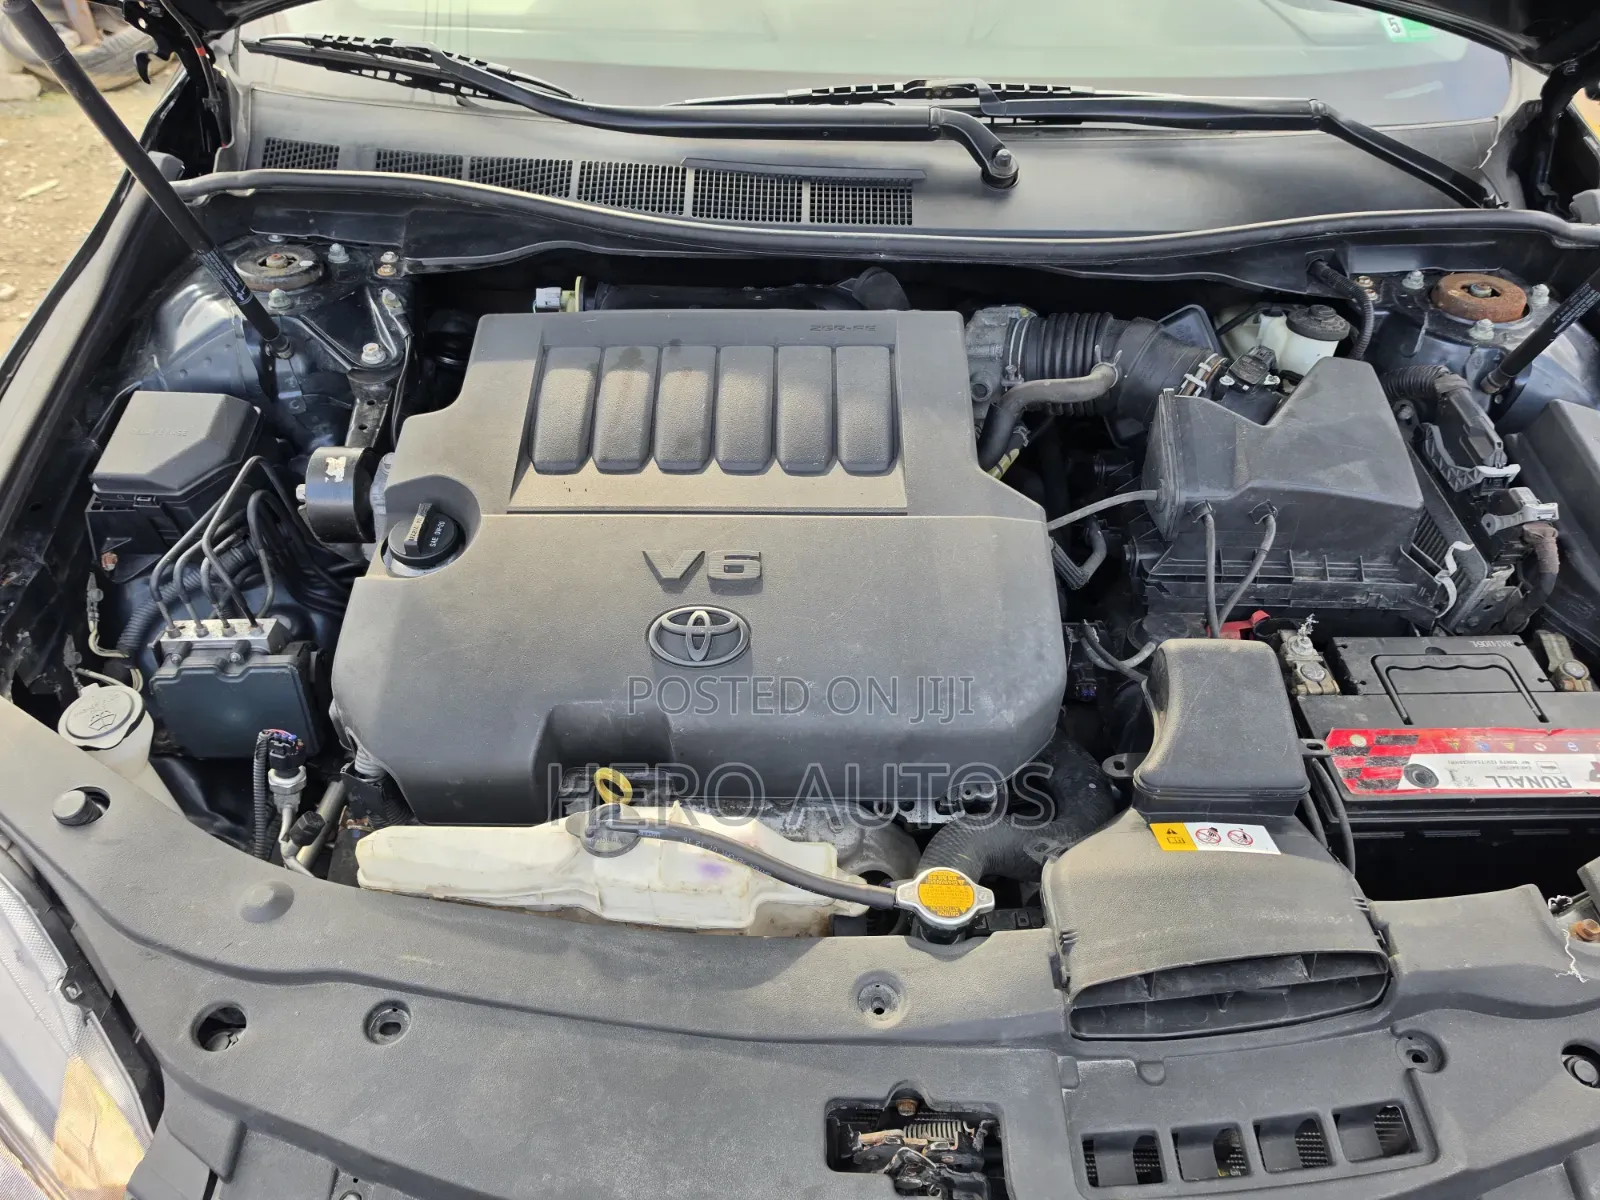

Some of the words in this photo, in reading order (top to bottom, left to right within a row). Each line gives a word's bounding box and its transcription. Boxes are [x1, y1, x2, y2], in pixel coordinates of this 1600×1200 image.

[429, 536, 440, 548] SAE
[641, 549, 762, 582] V6
[1484, 775, 1573, 788] RUNALL
